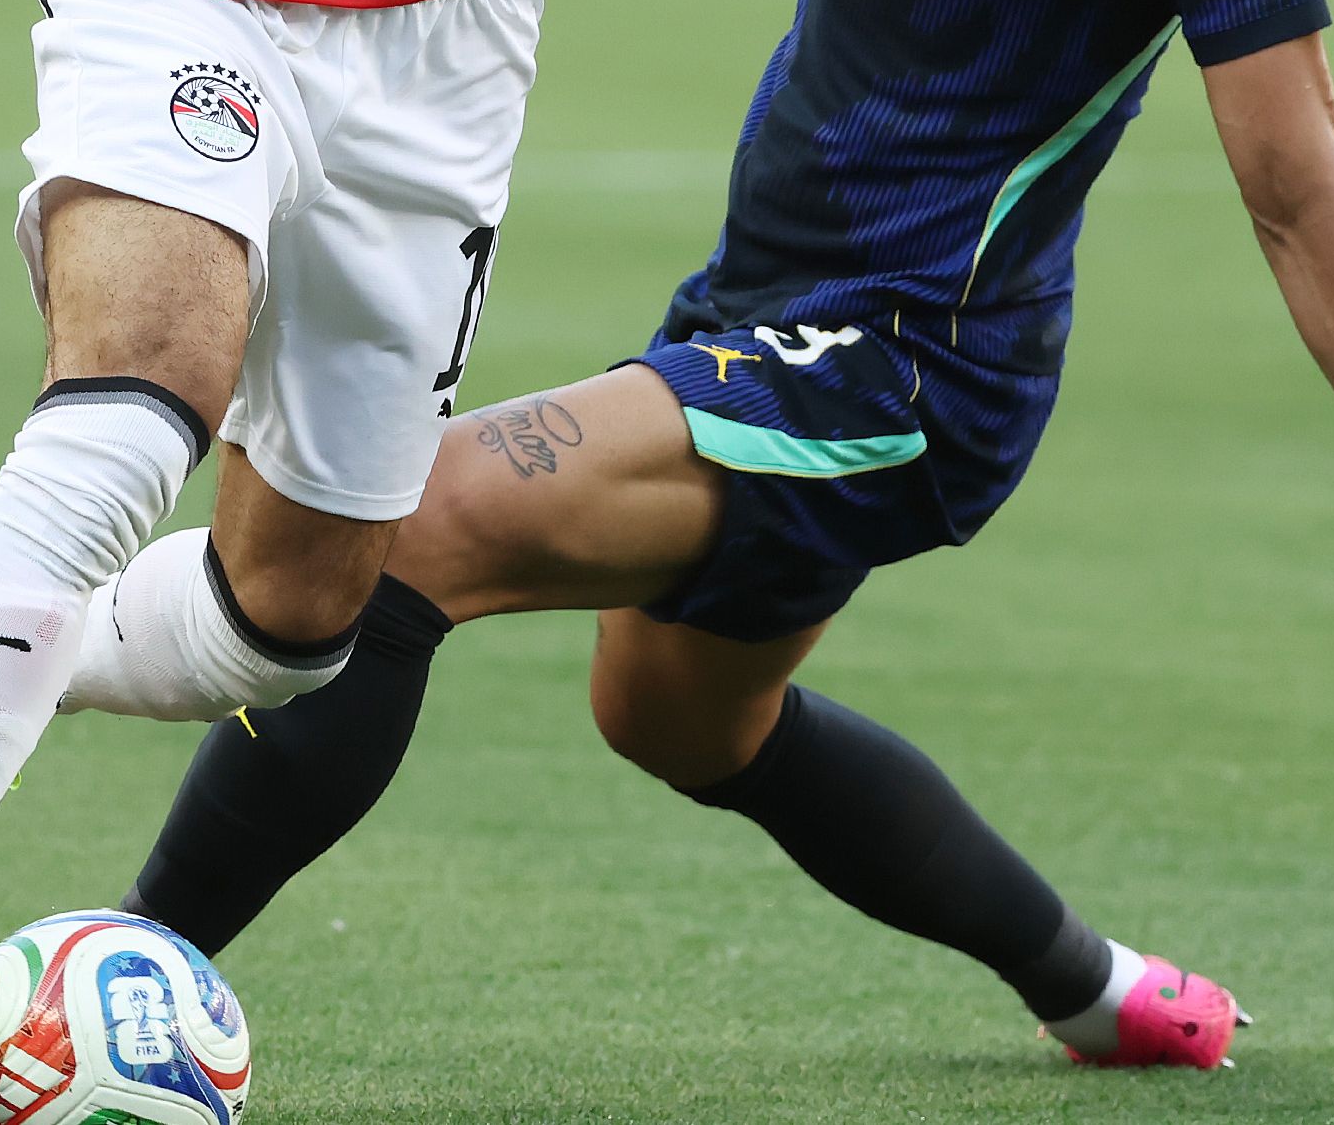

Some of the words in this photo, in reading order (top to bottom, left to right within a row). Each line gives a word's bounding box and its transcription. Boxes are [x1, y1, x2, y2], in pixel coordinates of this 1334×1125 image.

[194, 136, 226, 153] EGYPTIAN
[432, 224, 499, 392] 1
[136, 1045, 161, 1056] FIFA
